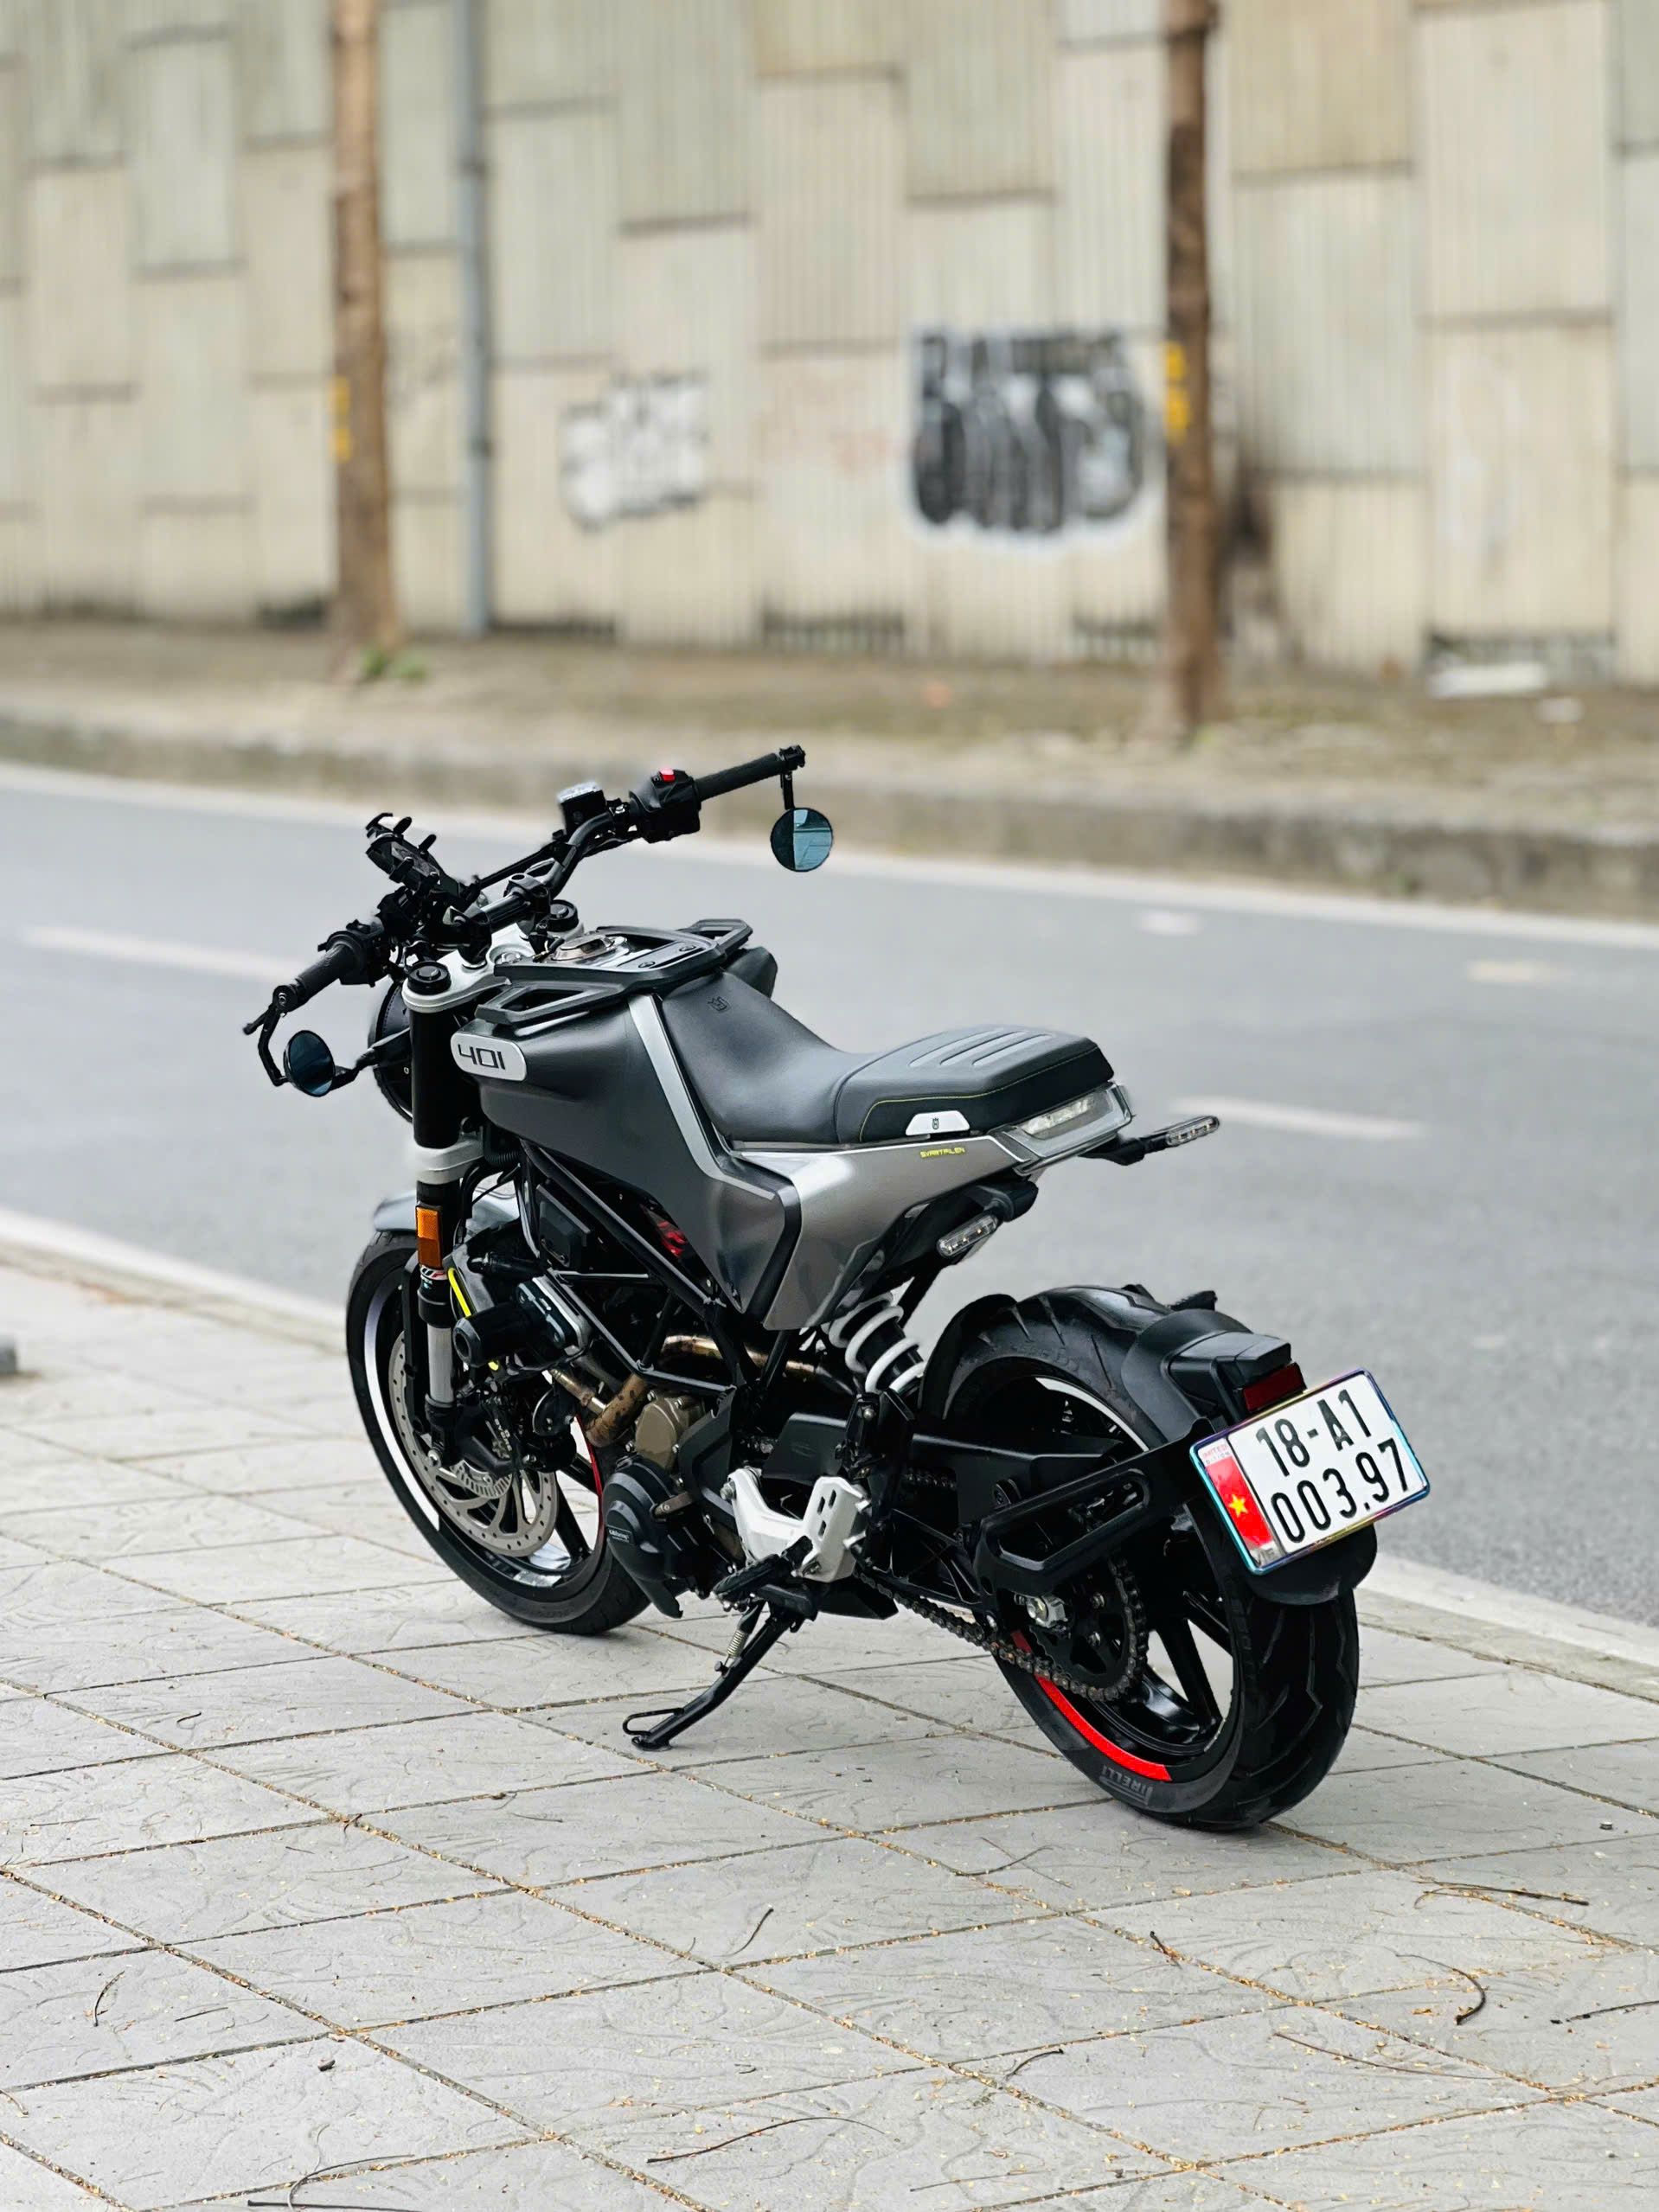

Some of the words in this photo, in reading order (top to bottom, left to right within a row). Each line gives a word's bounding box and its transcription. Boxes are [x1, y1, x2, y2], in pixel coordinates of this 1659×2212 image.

[458, 1043, 506, 1071] 401
[1255, 1389, 1372, 1477] 18-A1
[1271, 1437, 1408, 1544] 003.97
[1099, 1765, 1154, 1806] PIRELLI
